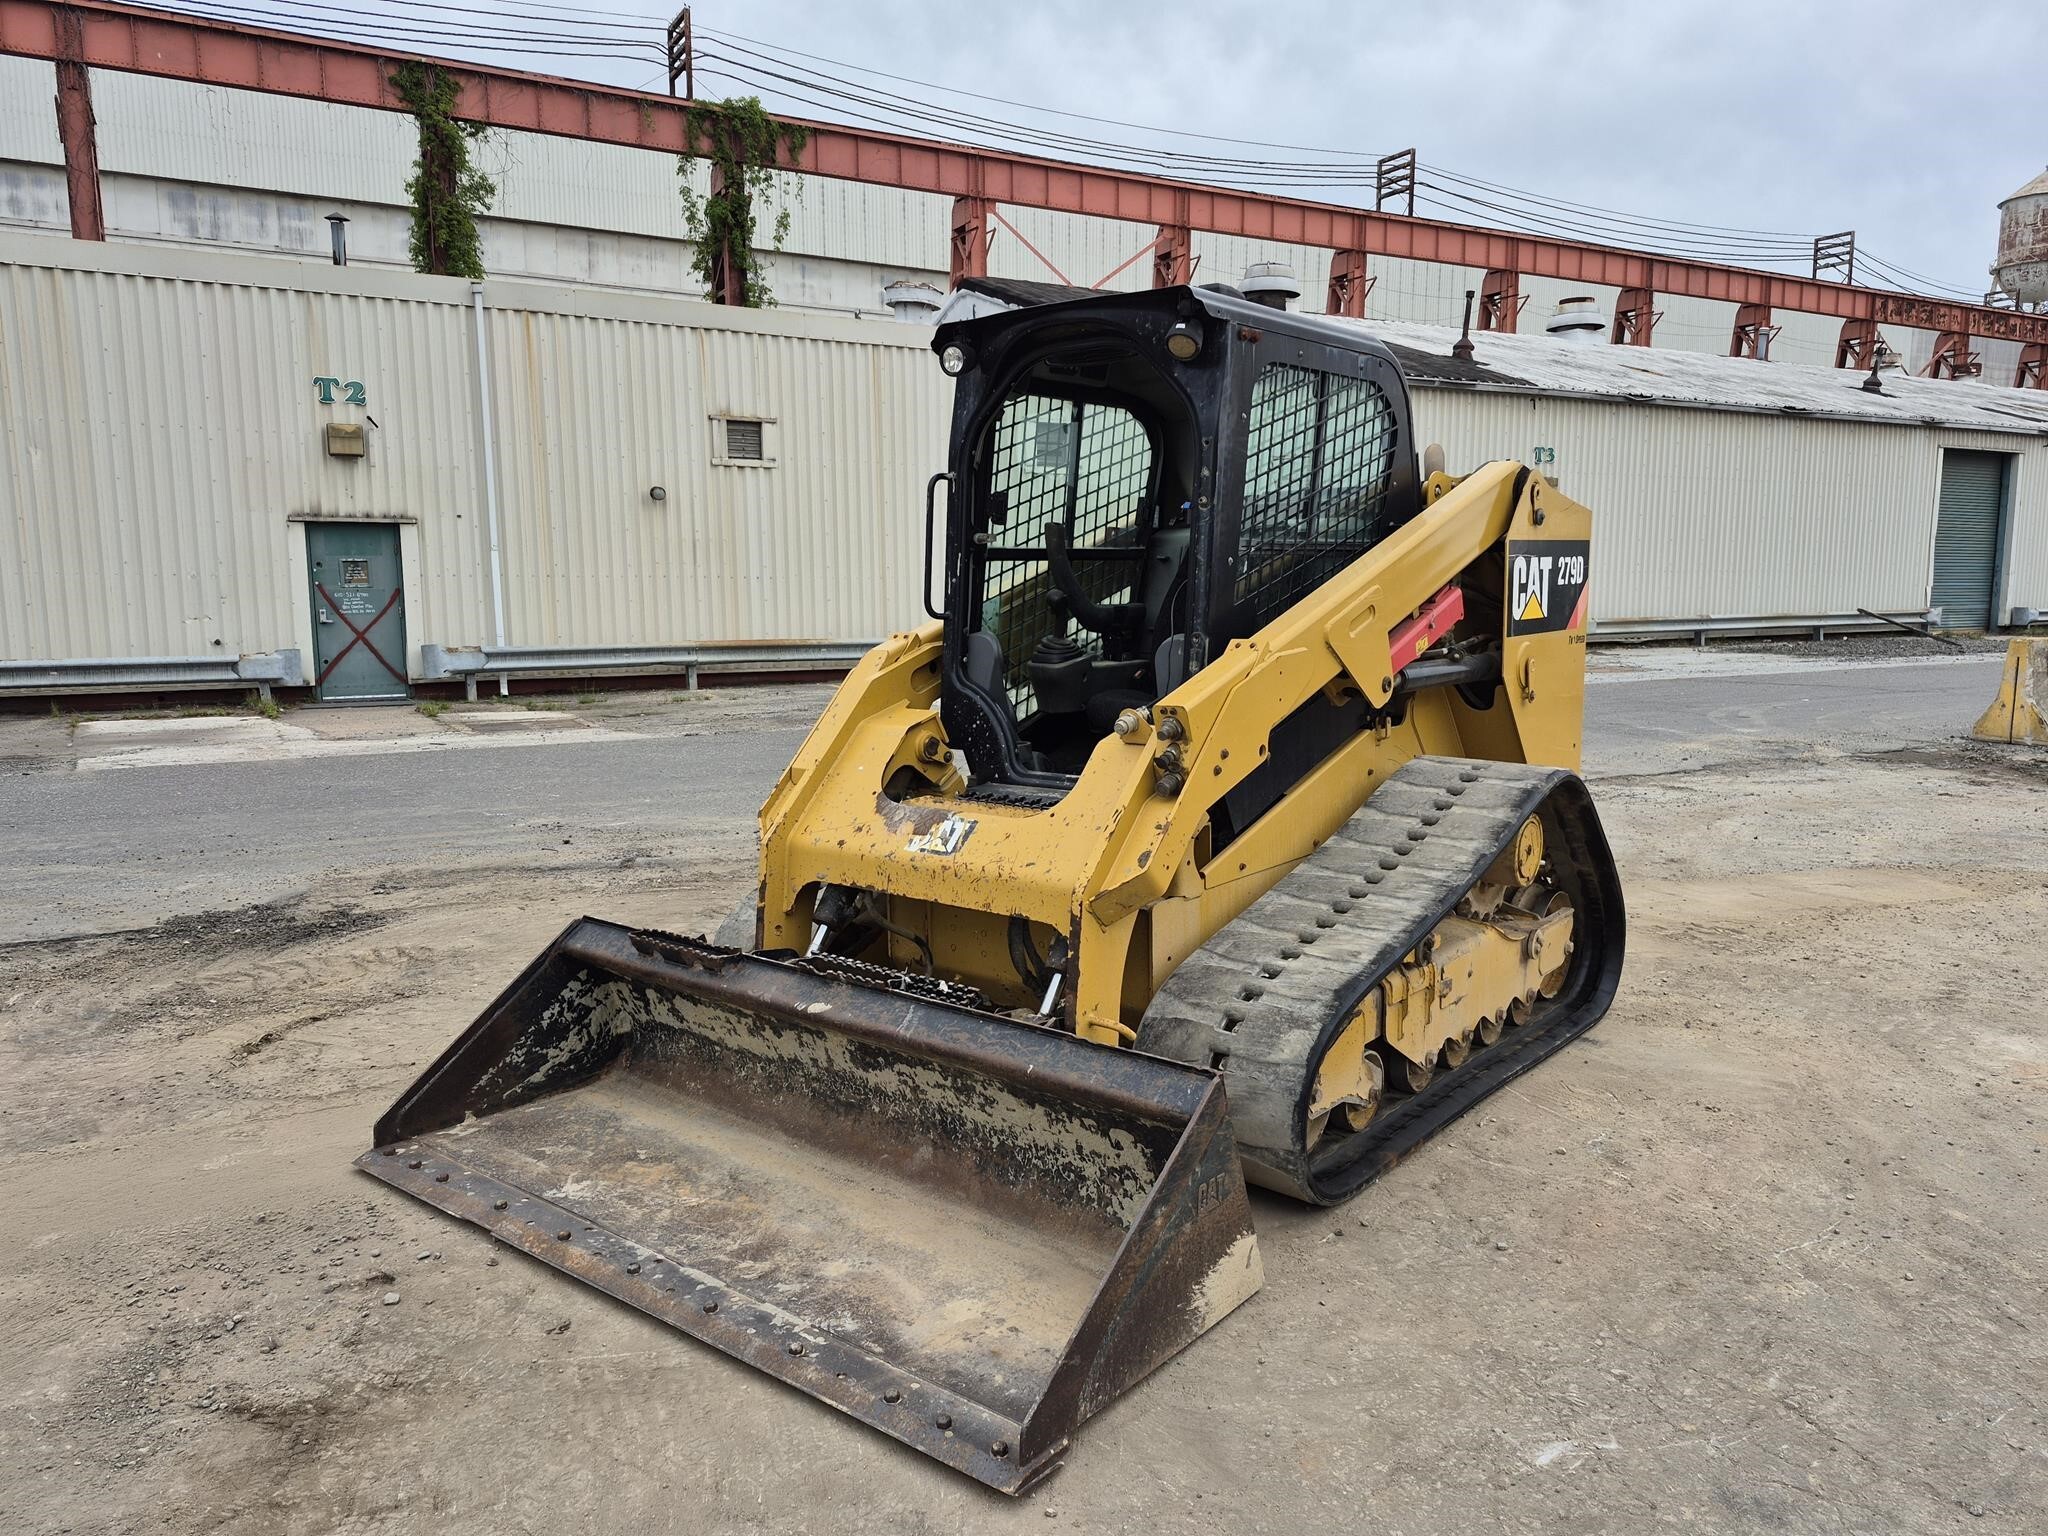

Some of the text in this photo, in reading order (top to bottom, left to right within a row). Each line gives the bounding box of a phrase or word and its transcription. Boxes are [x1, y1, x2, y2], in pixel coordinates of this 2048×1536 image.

[312, 375, 367, 405] T2
[1534, 446, 1555, 464] T3
[1512, 555, 1585, 621] CAT 279D
